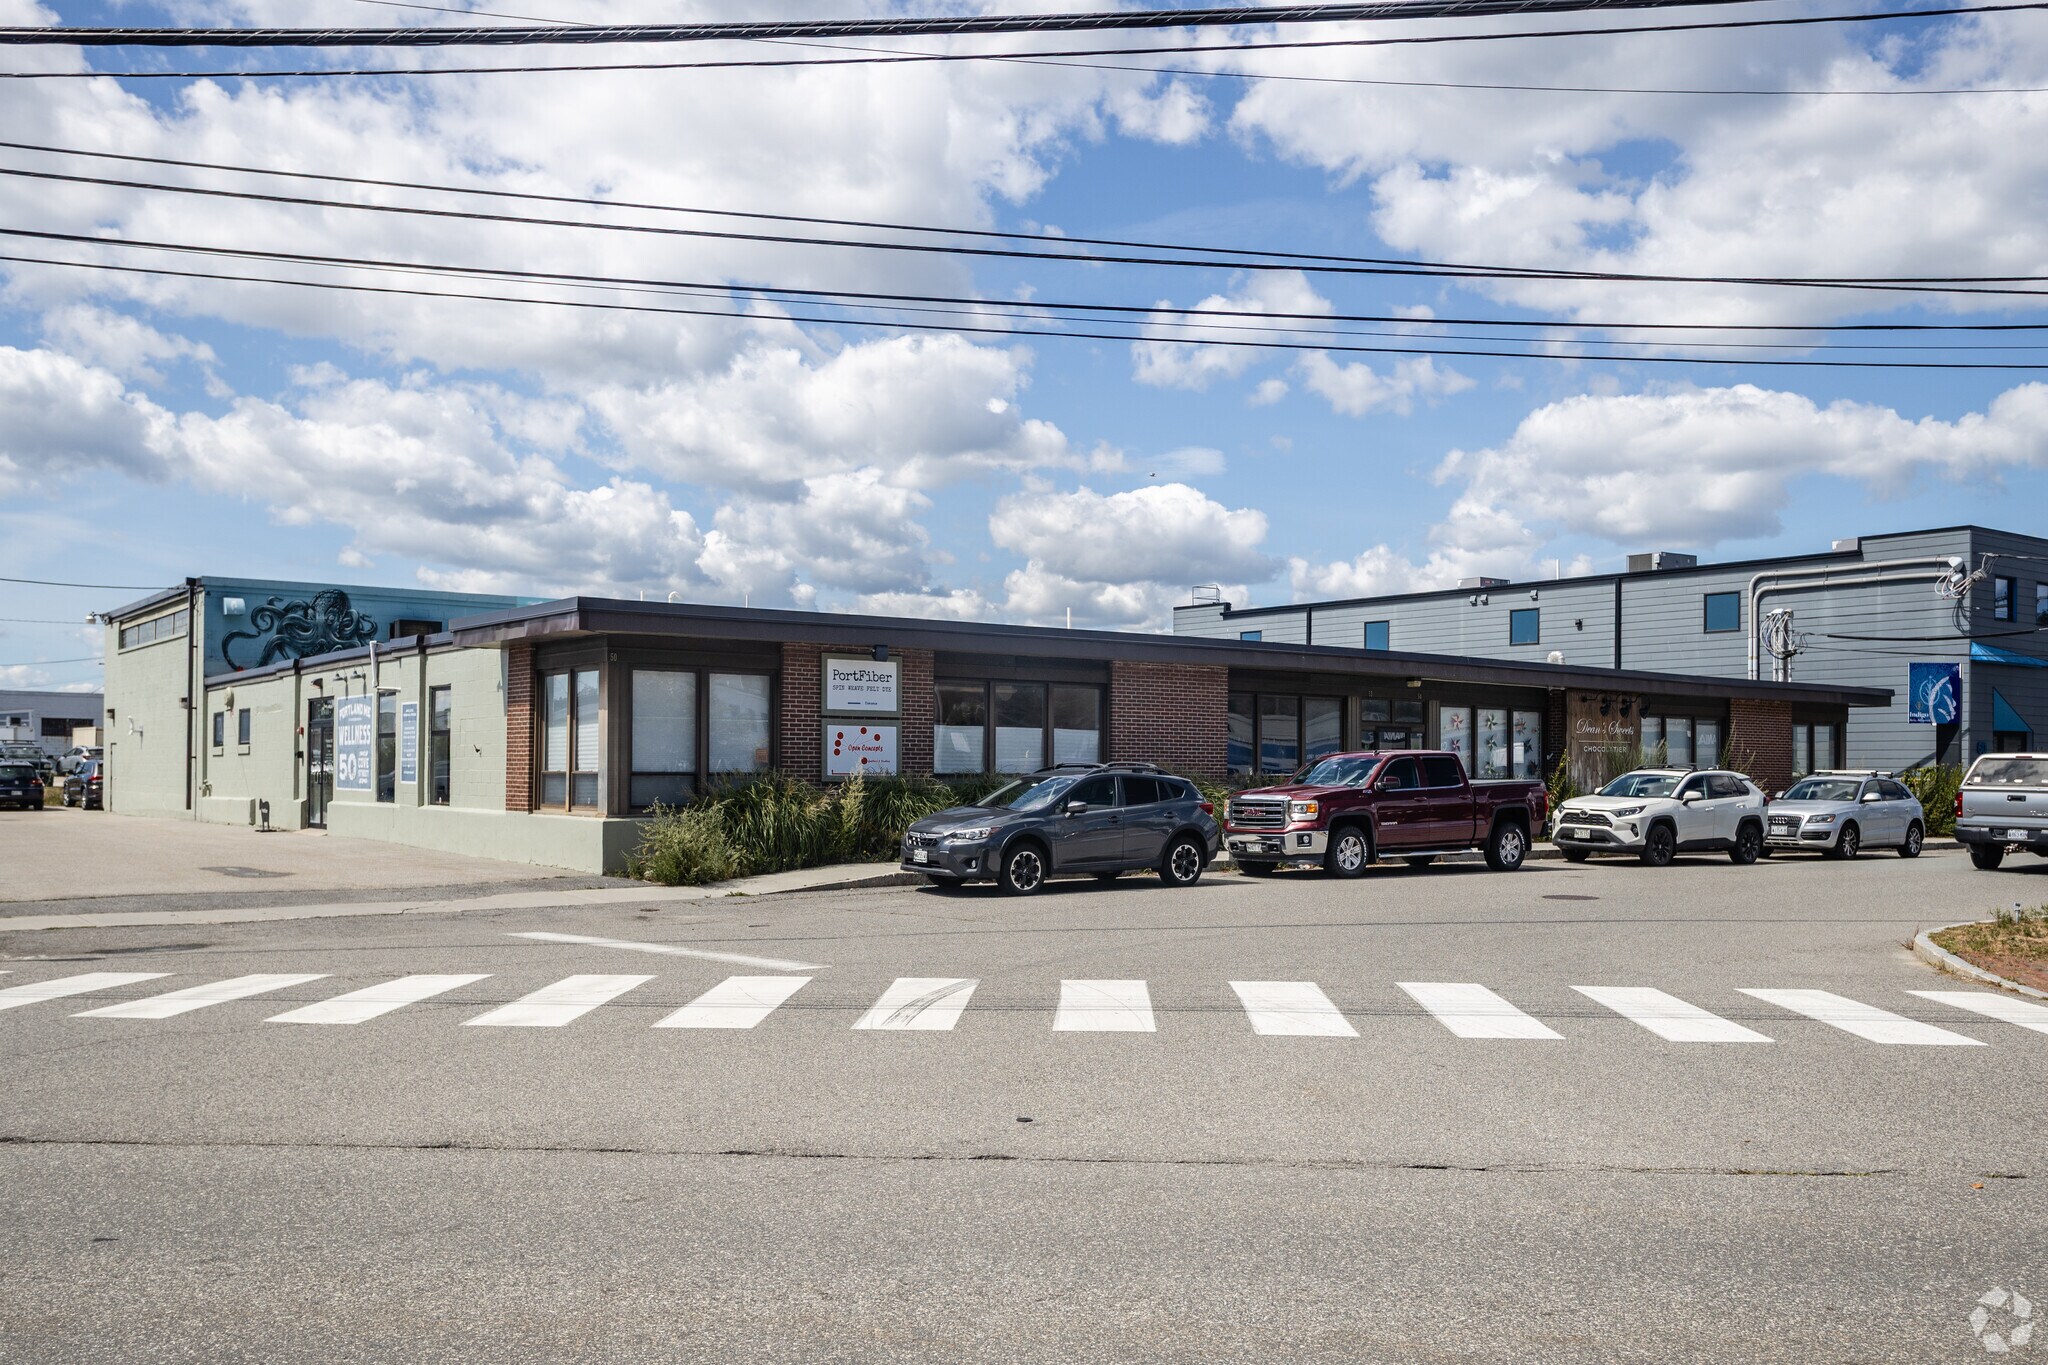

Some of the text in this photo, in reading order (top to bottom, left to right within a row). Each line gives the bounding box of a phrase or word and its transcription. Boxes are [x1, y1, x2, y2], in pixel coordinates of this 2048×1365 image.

[832, 668, 892, 683] PortFiber
[847, 684, 864, 692] WEAVE
[339, 703, 364, 721] PORTLAND
[363, 704, 371, 718] ME
[1909, 711, 1930, 720] Indigo
[1576, 718, 1635, 735] Dean's Sweets
[338, 724, 371, 746] WELLNESS
[848, 744, 884, 753] Open Concepts
[339, 752, 357, 781] 50
